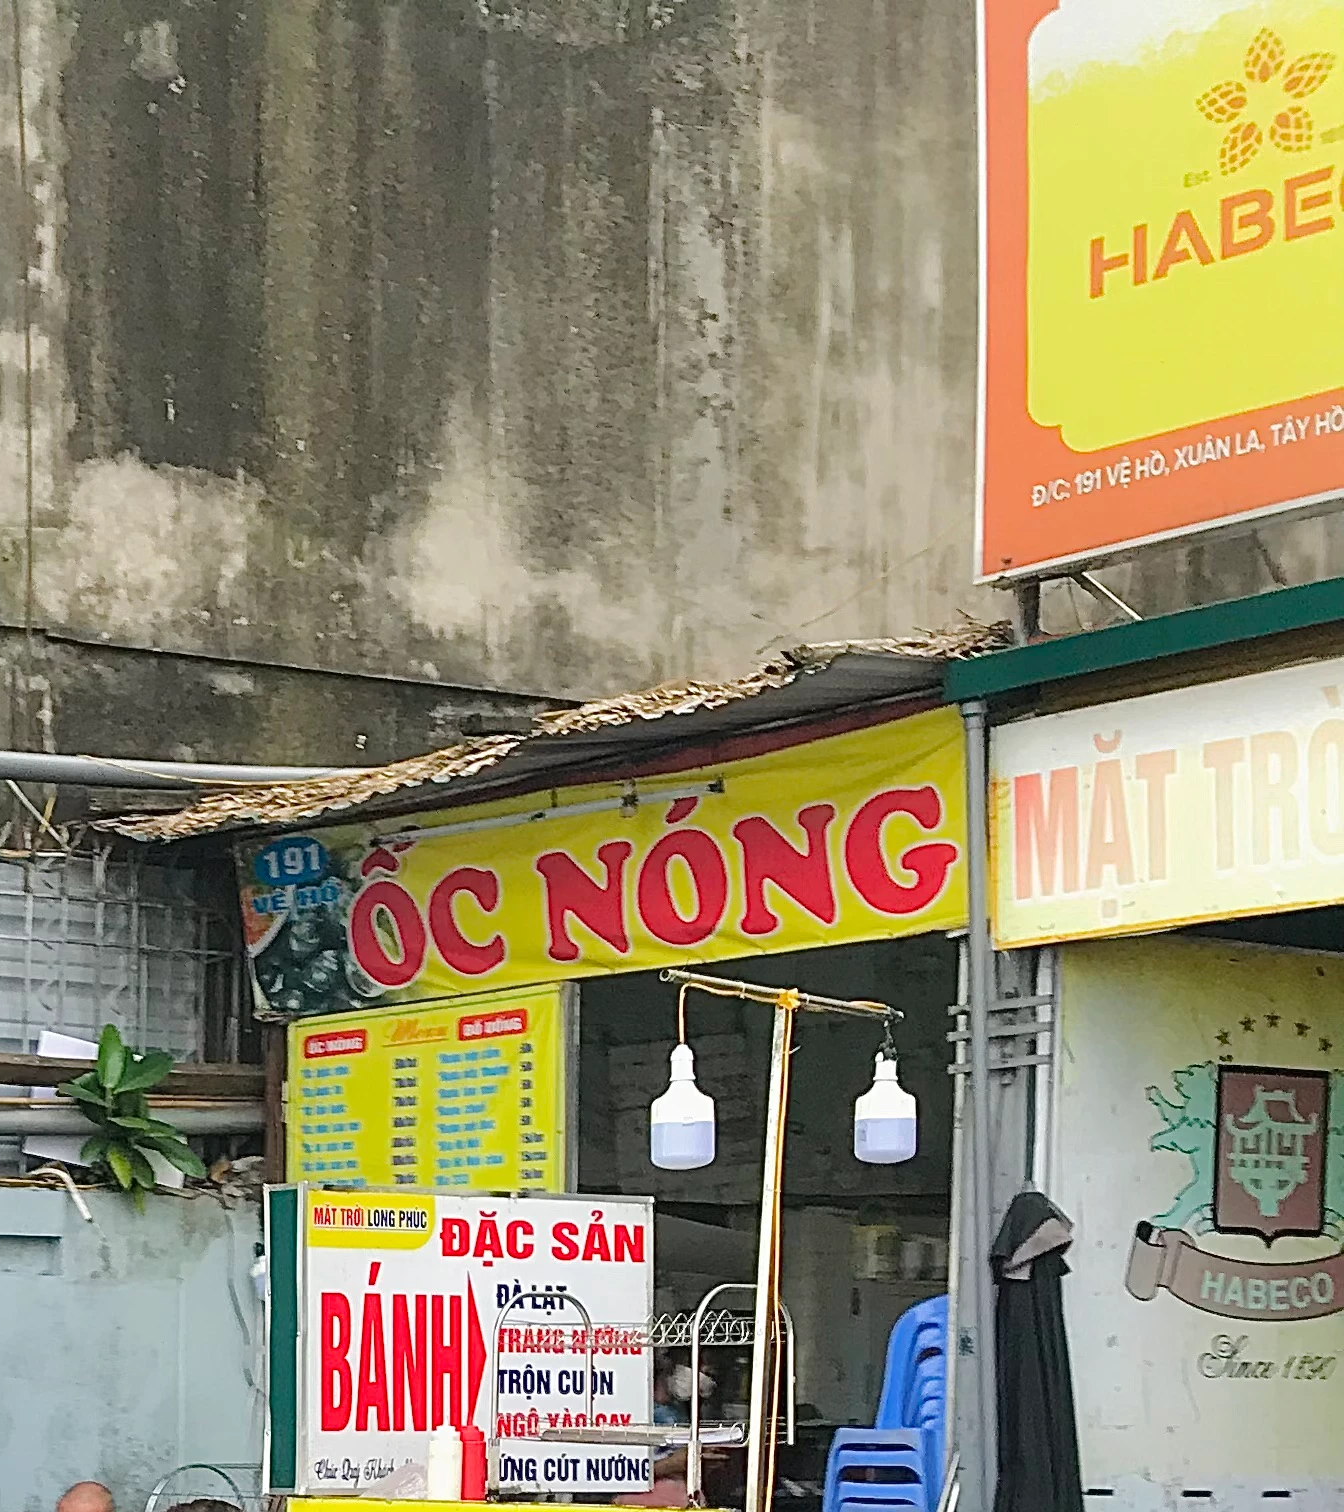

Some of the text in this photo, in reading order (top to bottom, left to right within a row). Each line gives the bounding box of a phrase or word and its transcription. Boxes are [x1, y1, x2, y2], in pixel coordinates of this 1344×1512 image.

[1089, 165, 1344, 299] HABE
[1074, 468, 1102, 495] 191
[1106, 456, 1132, 489] VỆ
[1173, 434, 1231, 470] XUÂN
[1269, 415, 1310, 446] TÂY
[1014, 729, 1177, 919] MẶT
[263, 843, 321, 878] 191
[350, 784, 958, 988] ỐC NÓNG
[367, 1209, 396, 1228] LONG
[398, 1206, 428, 1229] PHÚC
[440, 1209, 646, 1267] ĐẶC SẢN
[1199, 1270, 1335, 1311] HABECO
[320, 1261, 463, 1433] BÁNH
[498, 1363, 551, 1400] TRỘN
[496, 1407, 540, 1438] NGÔ
[543, 1453, 581, 1482] CÚT
